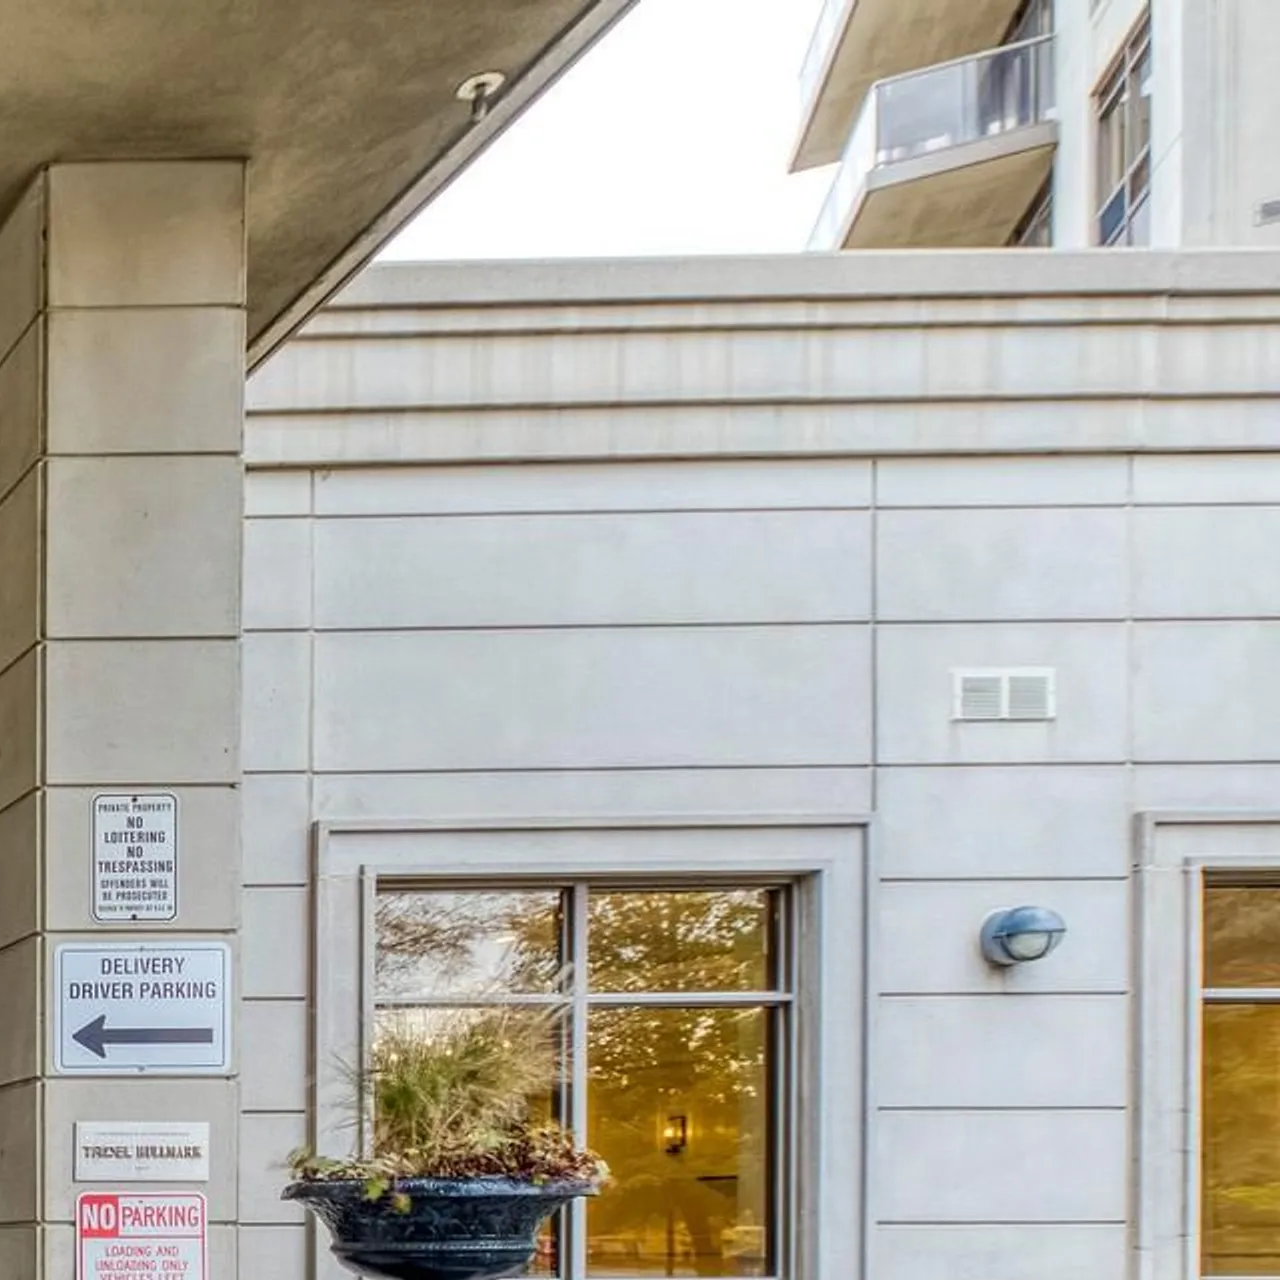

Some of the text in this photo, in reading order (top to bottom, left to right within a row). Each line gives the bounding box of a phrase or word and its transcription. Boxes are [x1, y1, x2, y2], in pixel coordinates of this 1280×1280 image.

[126, 816, 143, 829] NO
[104, 831, 165, 844] LOITERING
[126, 846, 143, 859] NO
[98, 860, 172, 873] TRESPASSING
[101, 958, 185, 975] DELIVERY
[69, 981, 216, 1000] DRIVER PARKING
[82, 1204, 199, 1230] NO PARKING
[105, 1246, 179, 1257] LOADING AND
[95, 1259, 189, 1271] UNLOADING ONLY
